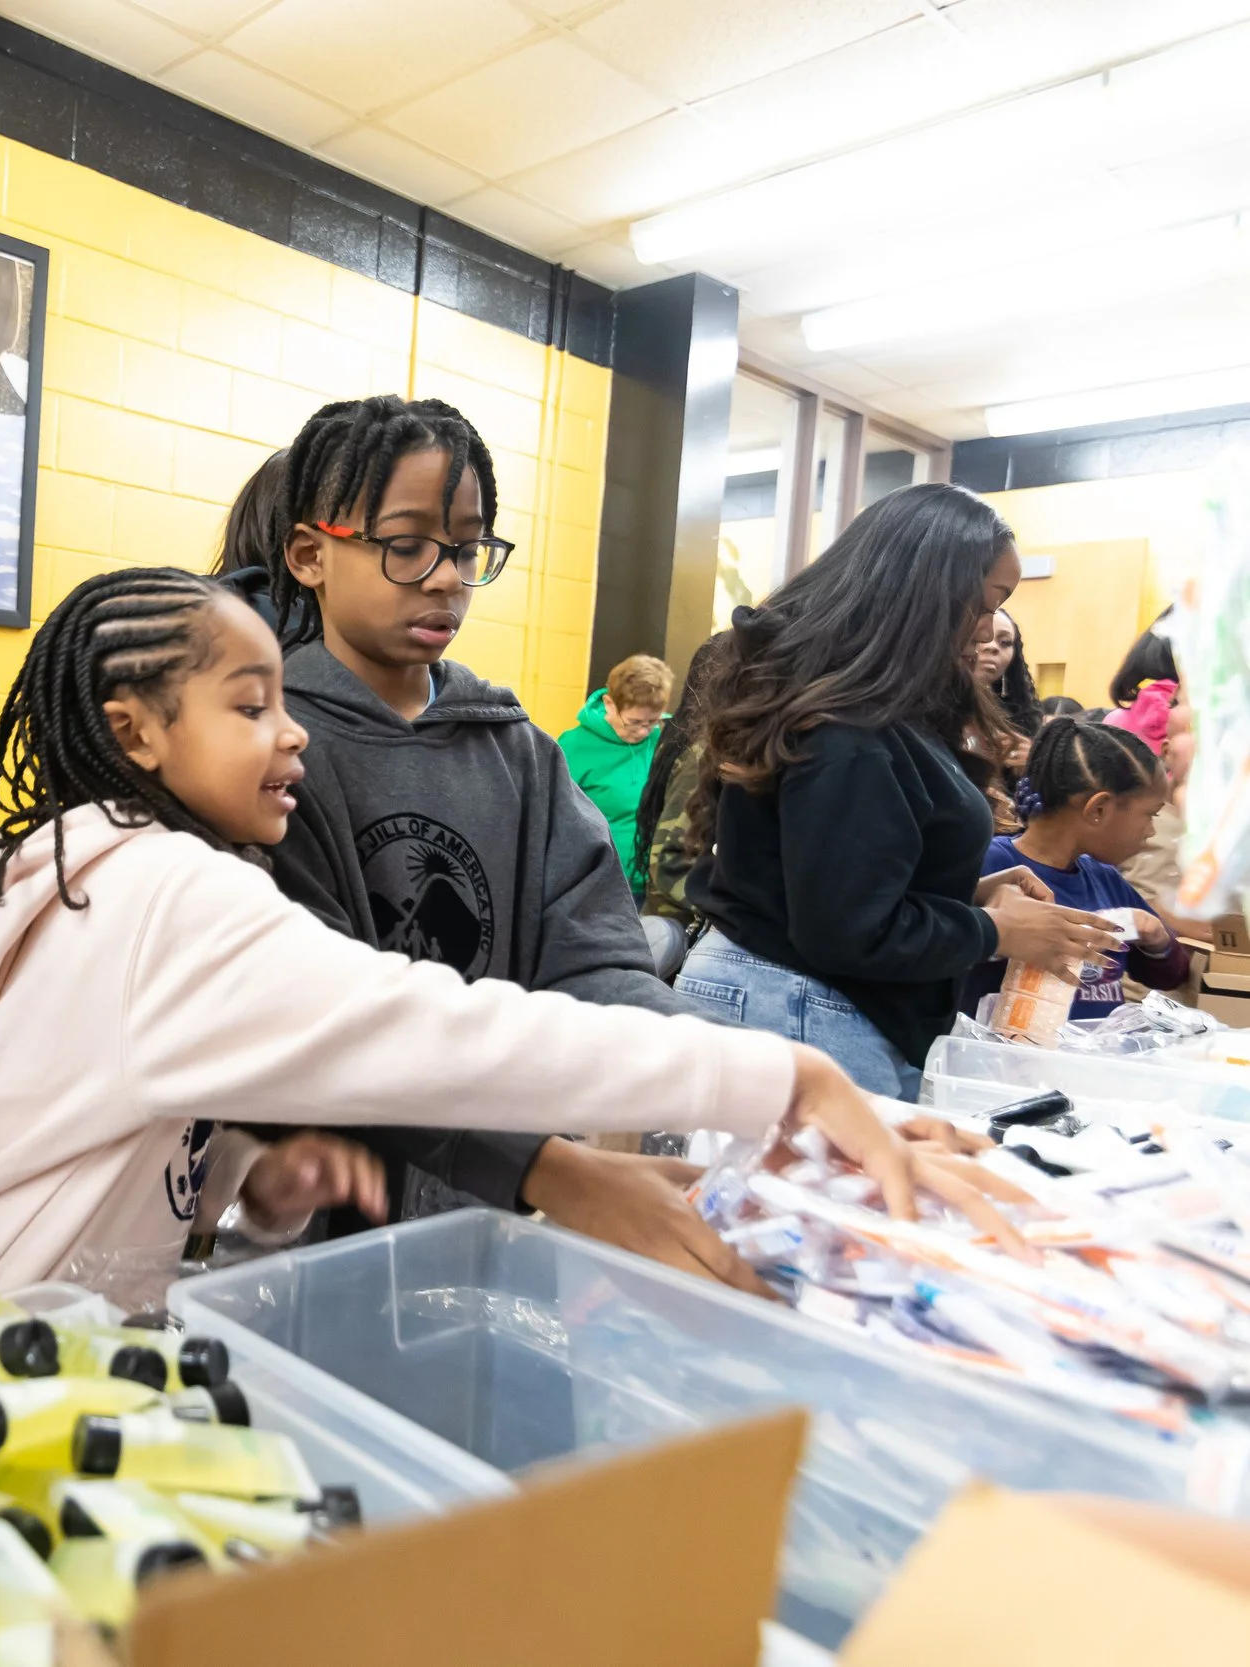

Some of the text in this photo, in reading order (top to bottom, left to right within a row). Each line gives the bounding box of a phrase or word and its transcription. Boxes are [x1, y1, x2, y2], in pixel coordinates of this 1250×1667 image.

[367, 820, 406, 849] JILL
[408, 819, 430, 837] OF
[433, 829, 489, 913] AMERICA
